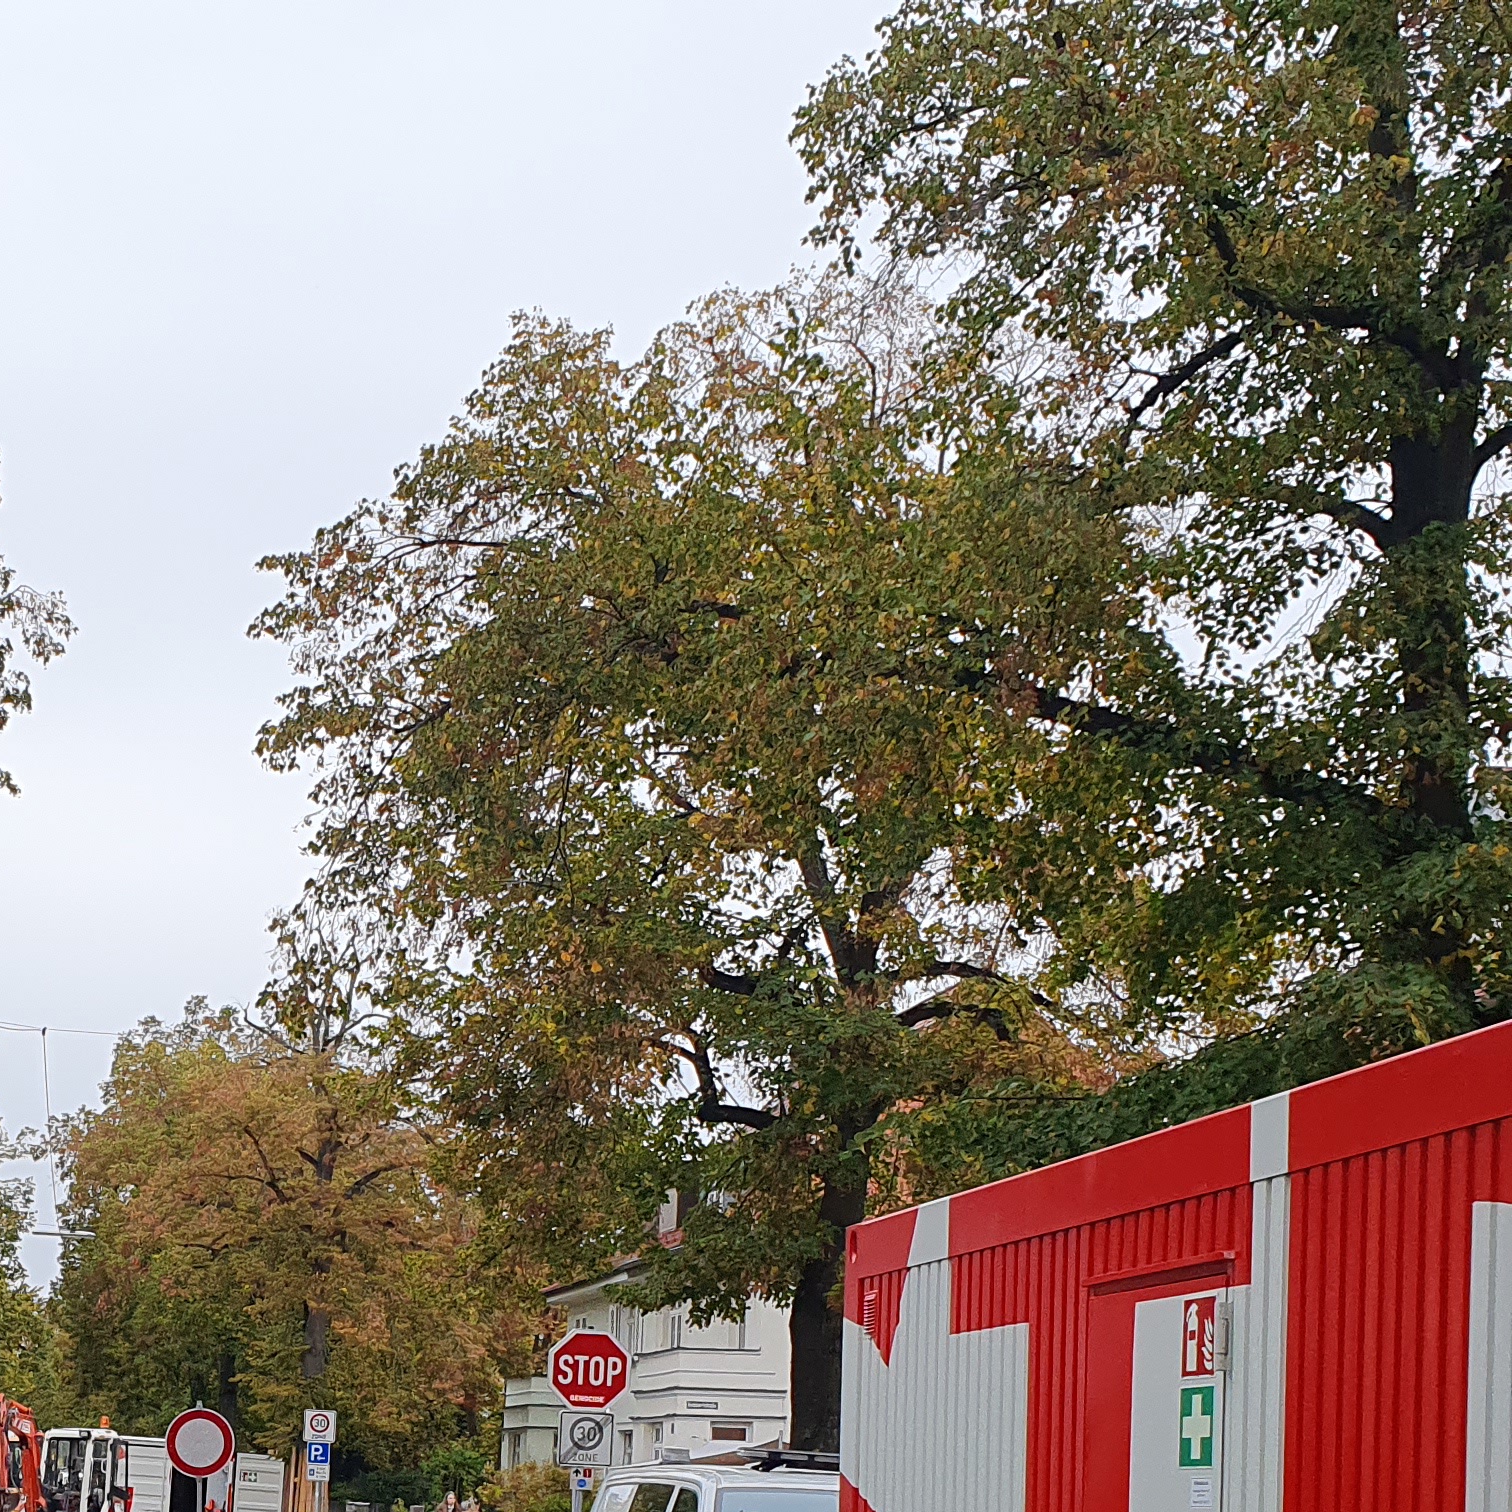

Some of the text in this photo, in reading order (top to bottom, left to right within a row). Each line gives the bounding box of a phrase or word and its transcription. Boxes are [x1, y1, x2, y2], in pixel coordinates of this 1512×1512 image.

[558, 1354, 622, 1386] STOP
[314, 1418, 326, 1428] 30
[576, 1426, 597, 1442] 30
[310, 1444, 323, 1461] P
[572, 1453, 598, 1462] ZONE
